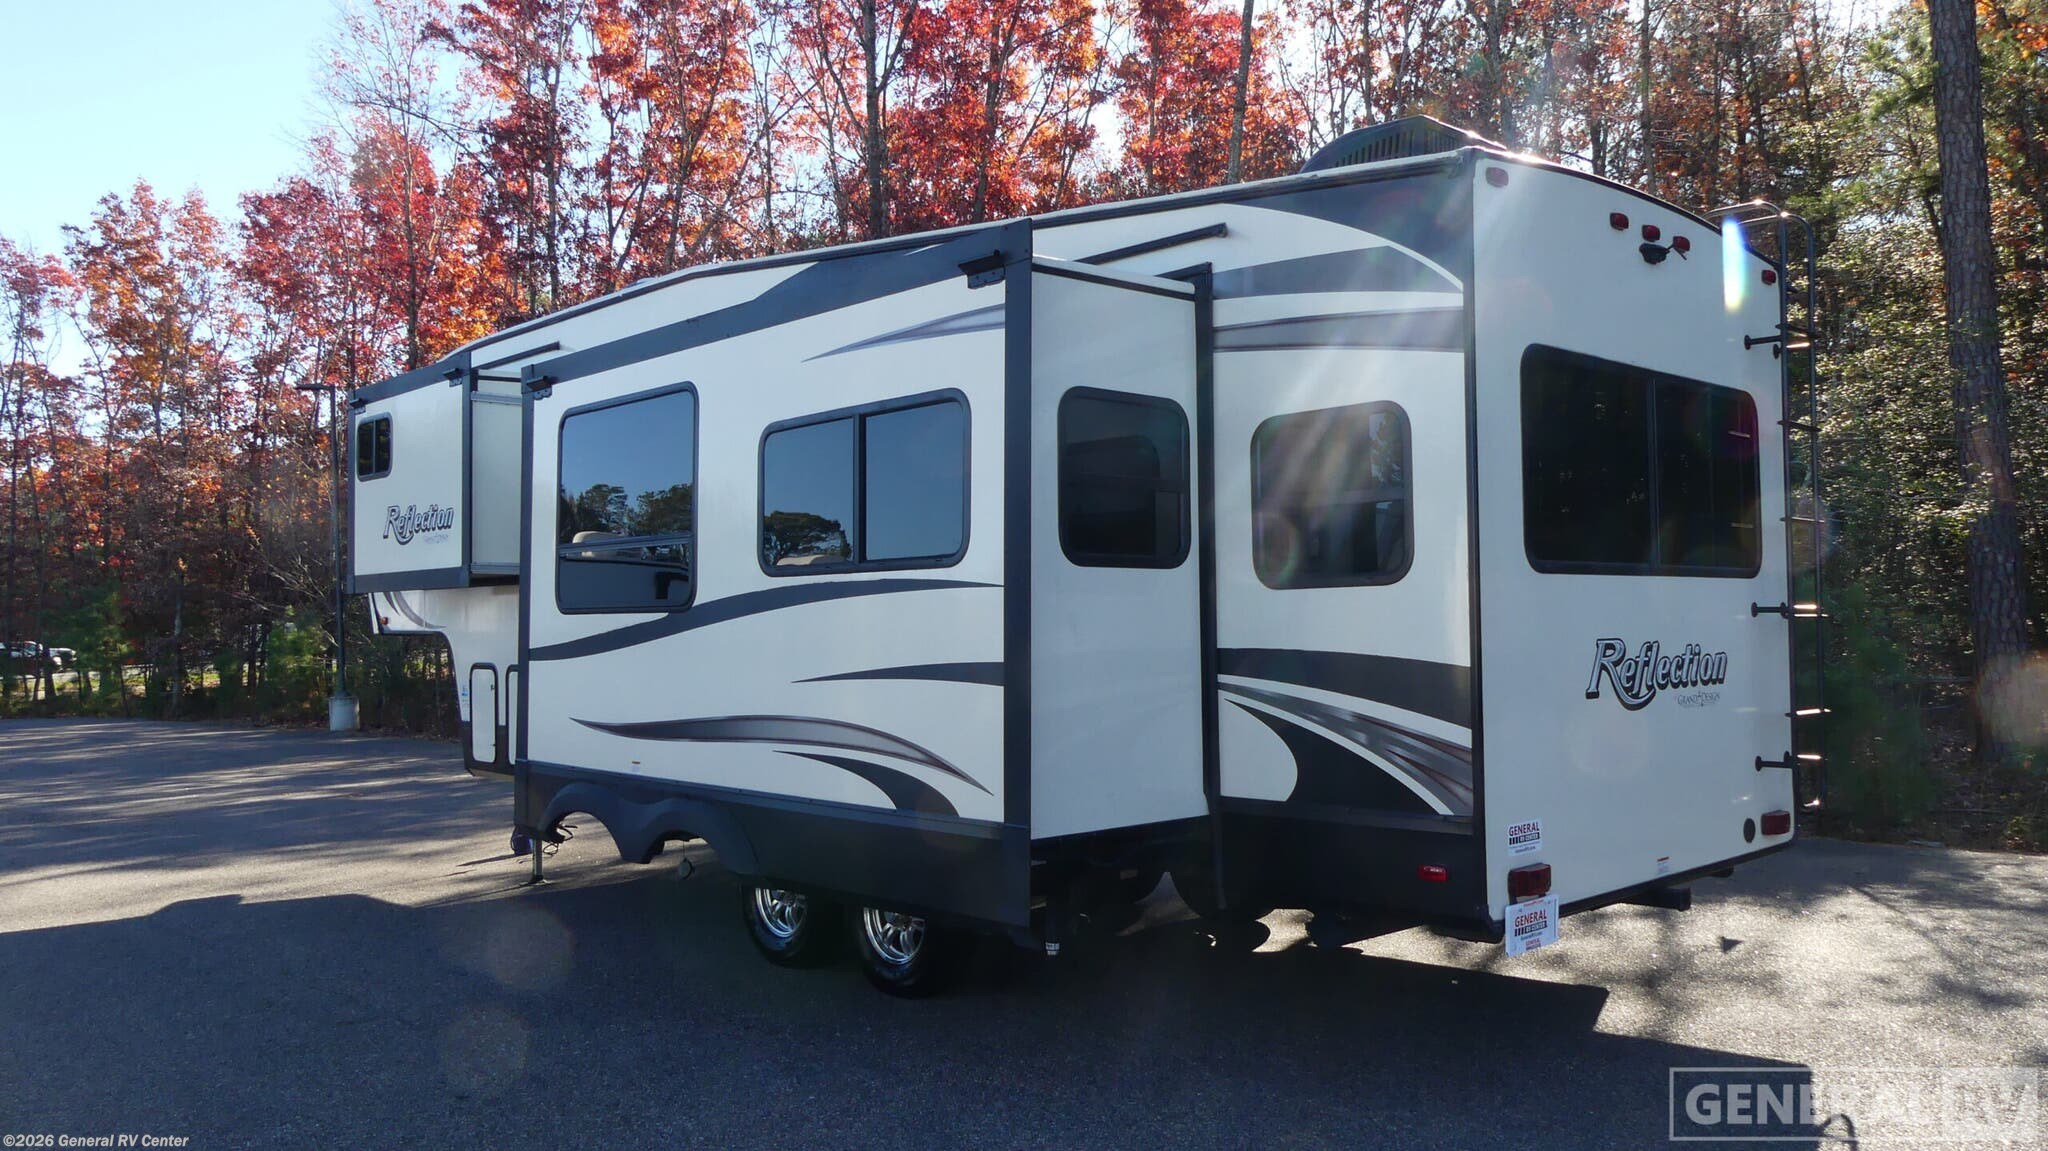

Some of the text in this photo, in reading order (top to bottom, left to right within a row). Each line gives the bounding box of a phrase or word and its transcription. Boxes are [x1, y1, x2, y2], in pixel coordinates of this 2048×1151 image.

[383, 504, 454, 545] Reflection
[1585, 638, 1727, 711] Reflection
[1509, 822, 1540, 837] GENERAL
[1515, 909, 1547, 928] GENERAL
